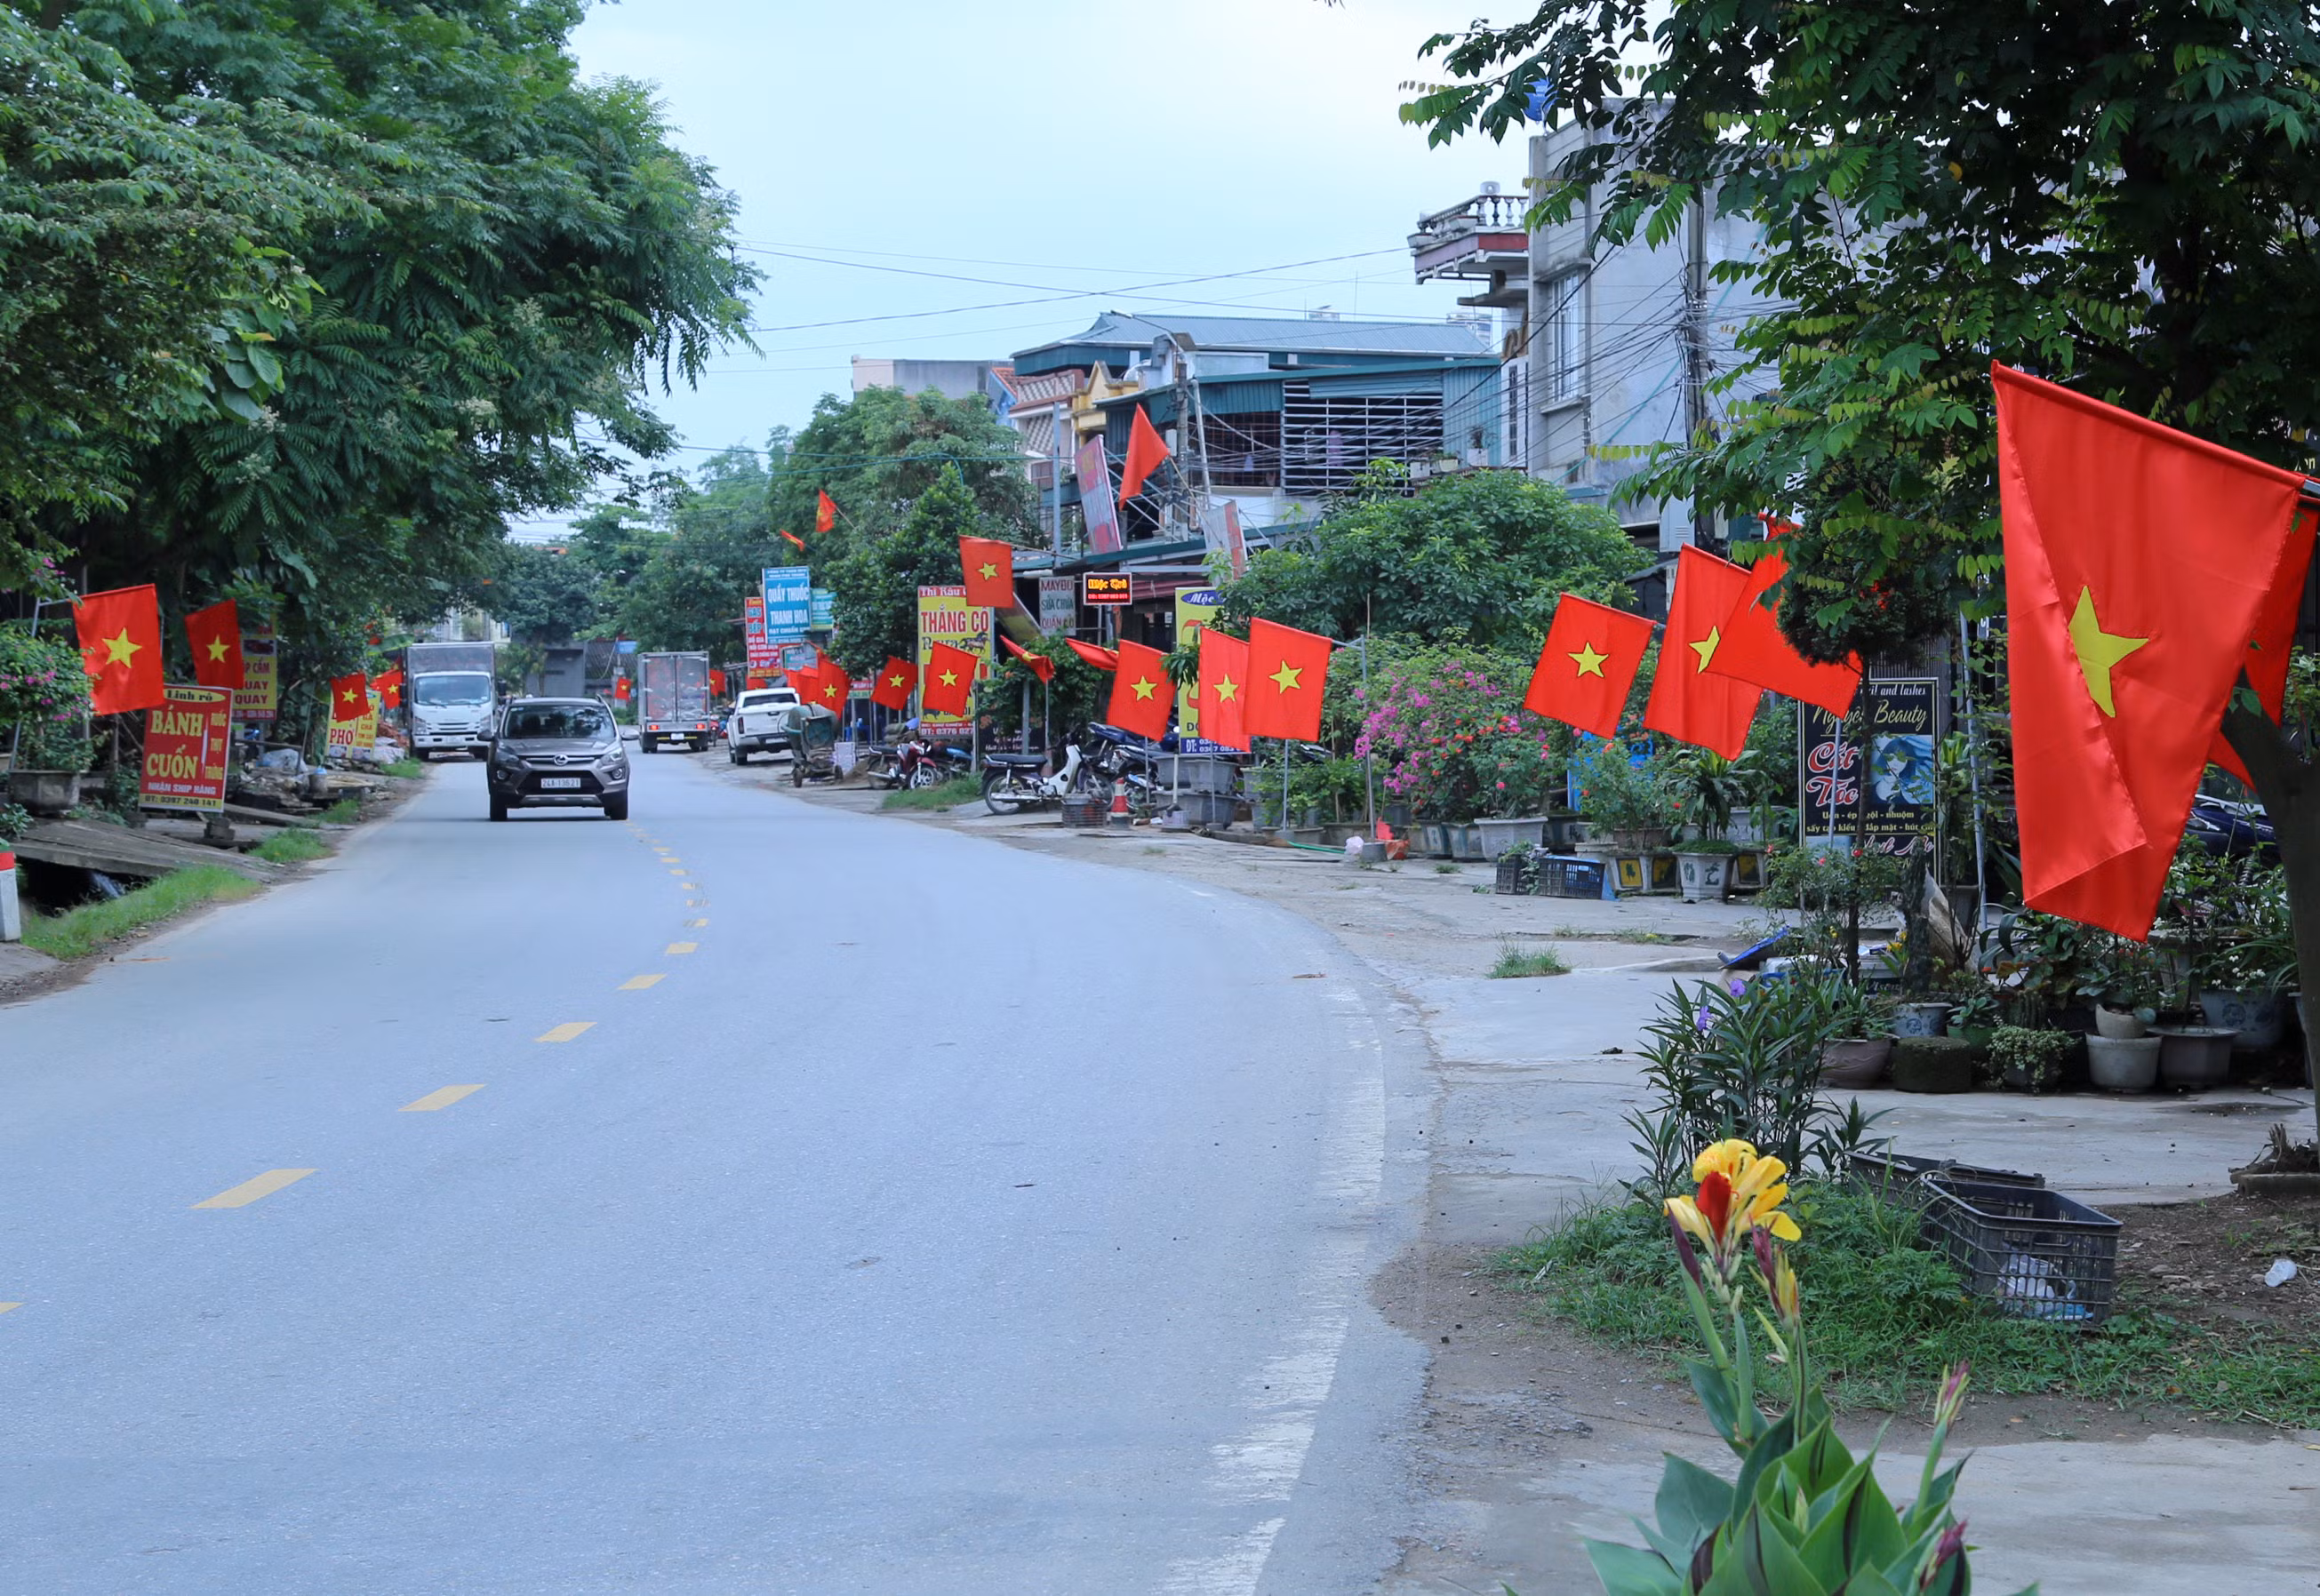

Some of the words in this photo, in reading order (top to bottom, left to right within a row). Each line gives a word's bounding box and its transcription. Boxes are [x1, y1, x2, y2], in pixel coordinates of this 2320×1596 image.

[244, 680, 269, 690] UAY
[1880, 683, 1898, 696] and
[1900, 683, 1926, 696] lashes
[167, 690, 196, 700] Linh
[235, 694, 268, 705] QUAY
[150, 704, 204, 737] BÁNH
[1874, 698, 1927, 731] Beauty
[146, 744, 198, 779] CUỐN
[148, 781, 172, 793] NHẬN
[172, 783, 192, 793] SHIP
[194, 784, 216, 795] HÀNG
[1885, 810, 1914, 819] nhuộm
